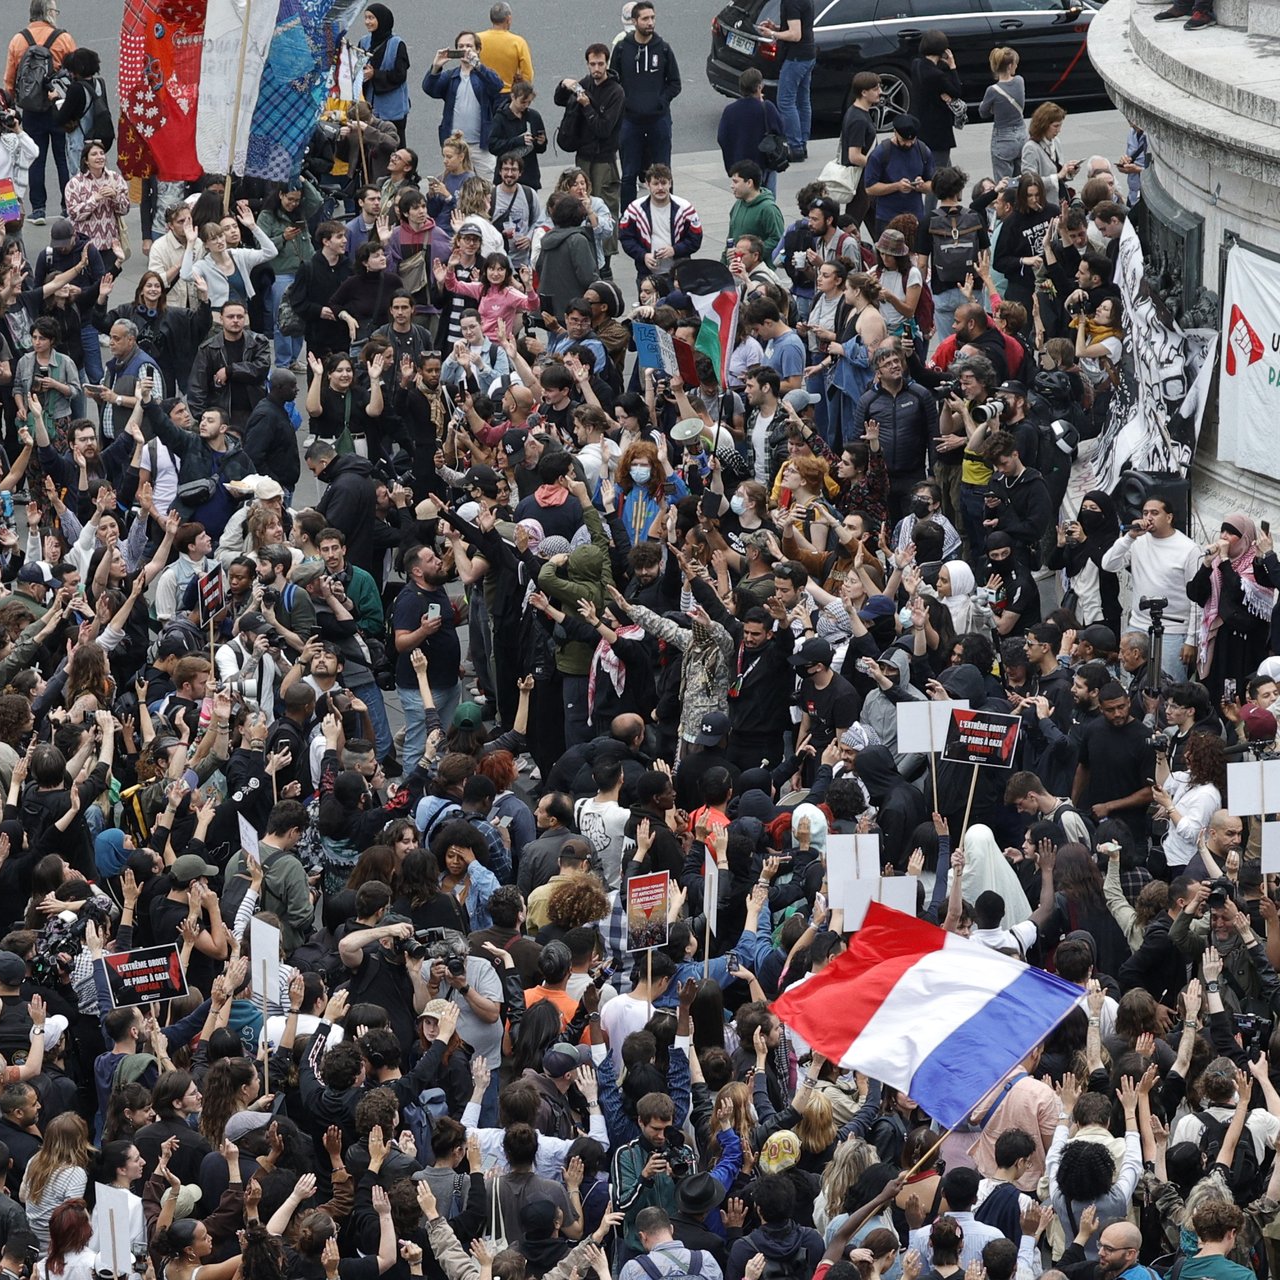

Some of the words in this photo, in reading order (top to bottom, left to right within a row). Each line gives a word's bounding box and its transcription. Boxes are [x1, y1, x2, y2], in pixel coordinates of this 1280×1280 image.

[959, 720, 988, 731] L'EXTRÊME
[989, 723, 1007, 733] DROITE
[960, 735, 966, 743] DE
[967, 736, 983, 745] PARIS
[989, 739, 1002, 747] GAZA
[117, 960, 148, 973] L'EXTRÊME
[148, 957, 168, 967] DROITE
[123, 978, 132, 987] DE
[132, 976, 149, 985] PARIS
[155, 972, 170, 981] GAZA
